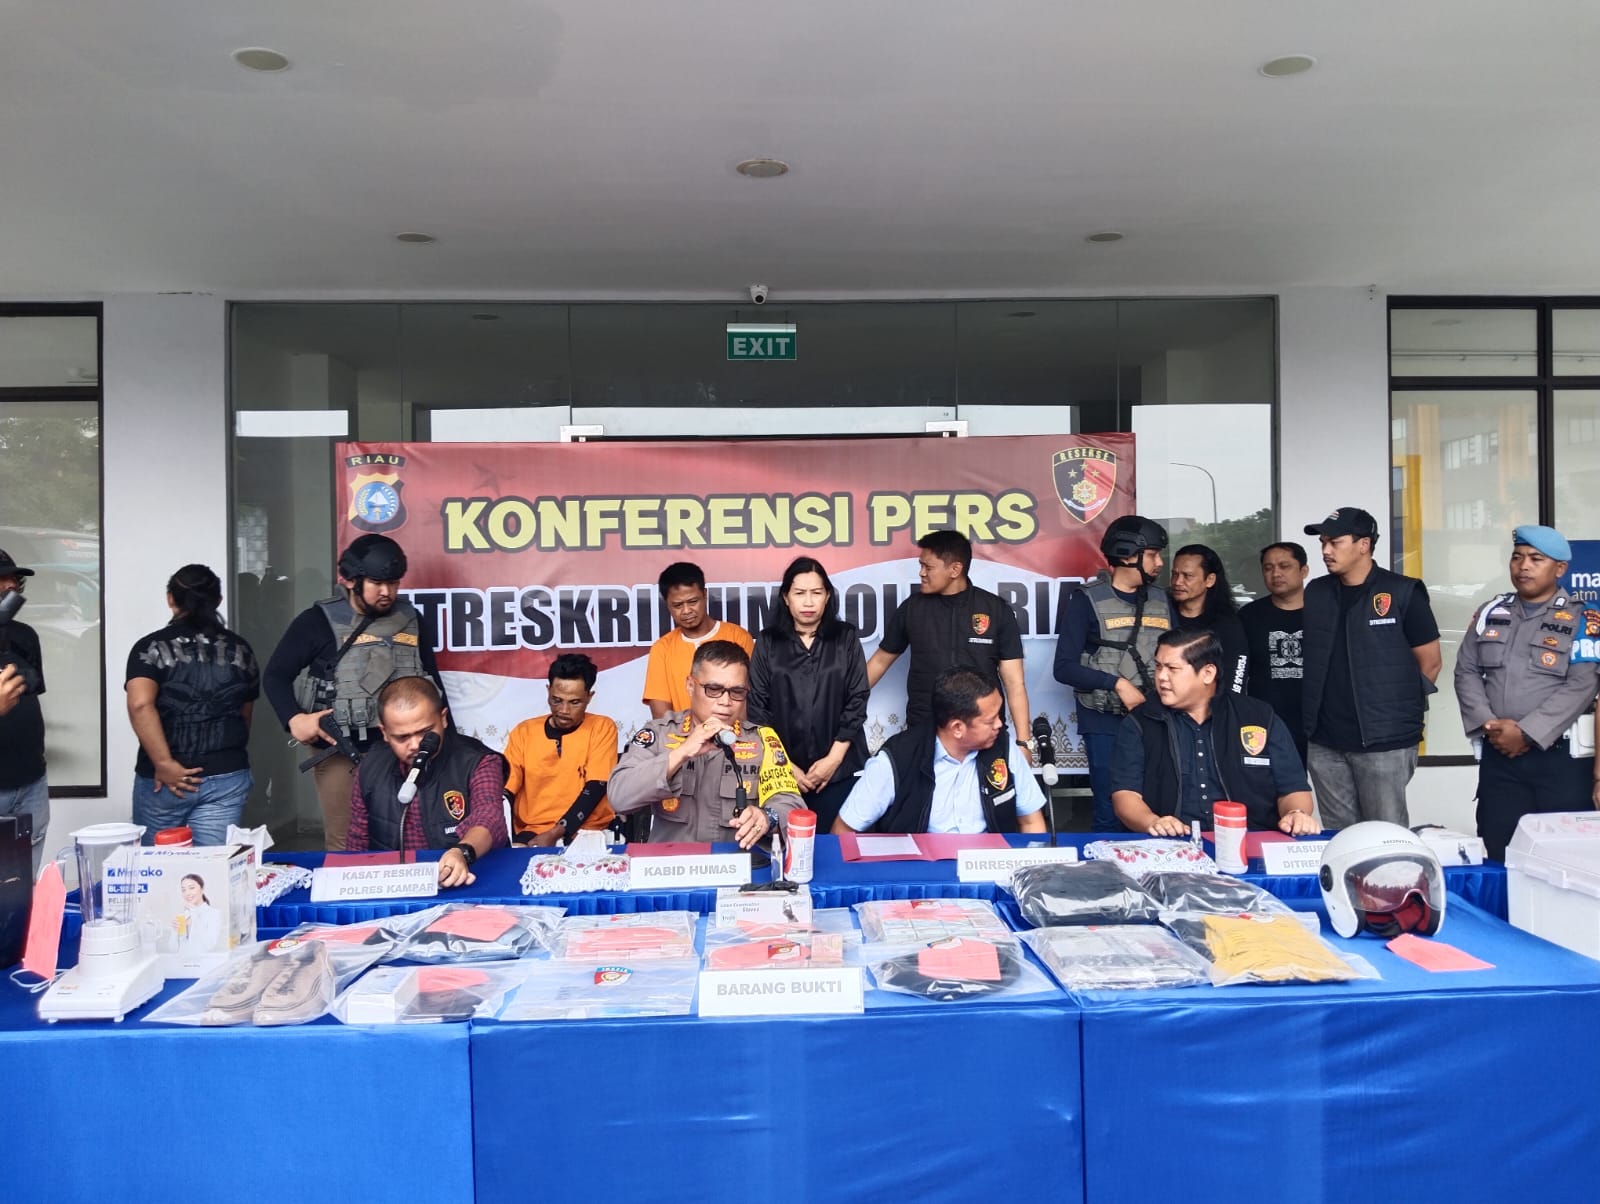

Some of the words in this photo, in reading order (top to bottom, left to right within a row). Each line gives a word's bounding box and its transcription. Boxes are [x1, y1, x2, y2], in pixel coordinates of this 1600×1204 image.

[733, 337, 790, 355] EXIT
[351, 454, 399, 466] RIAU
[1060, 448, 1109, 461] RESERSE
[444, 496, 849, 549] KONFERENSI
[871, 492, 1035, 542] PERS
[1572, 590, 1597, 601] atm
[1541, 622, 1572, 635] POLRI
[342, 870, 380, 881] KASAT
[383, 867, 434, 879] RESKRIM
[644, 866, 685, 877] KABID
[689, 864, 737, 875] HUMAS
[339, 885, 384, 896] POLRES
[387, 883, 434, 894] KAMPAR
[717, 983, 786, 996] BARANG
[791, 981, 842, 994] BUKTI
